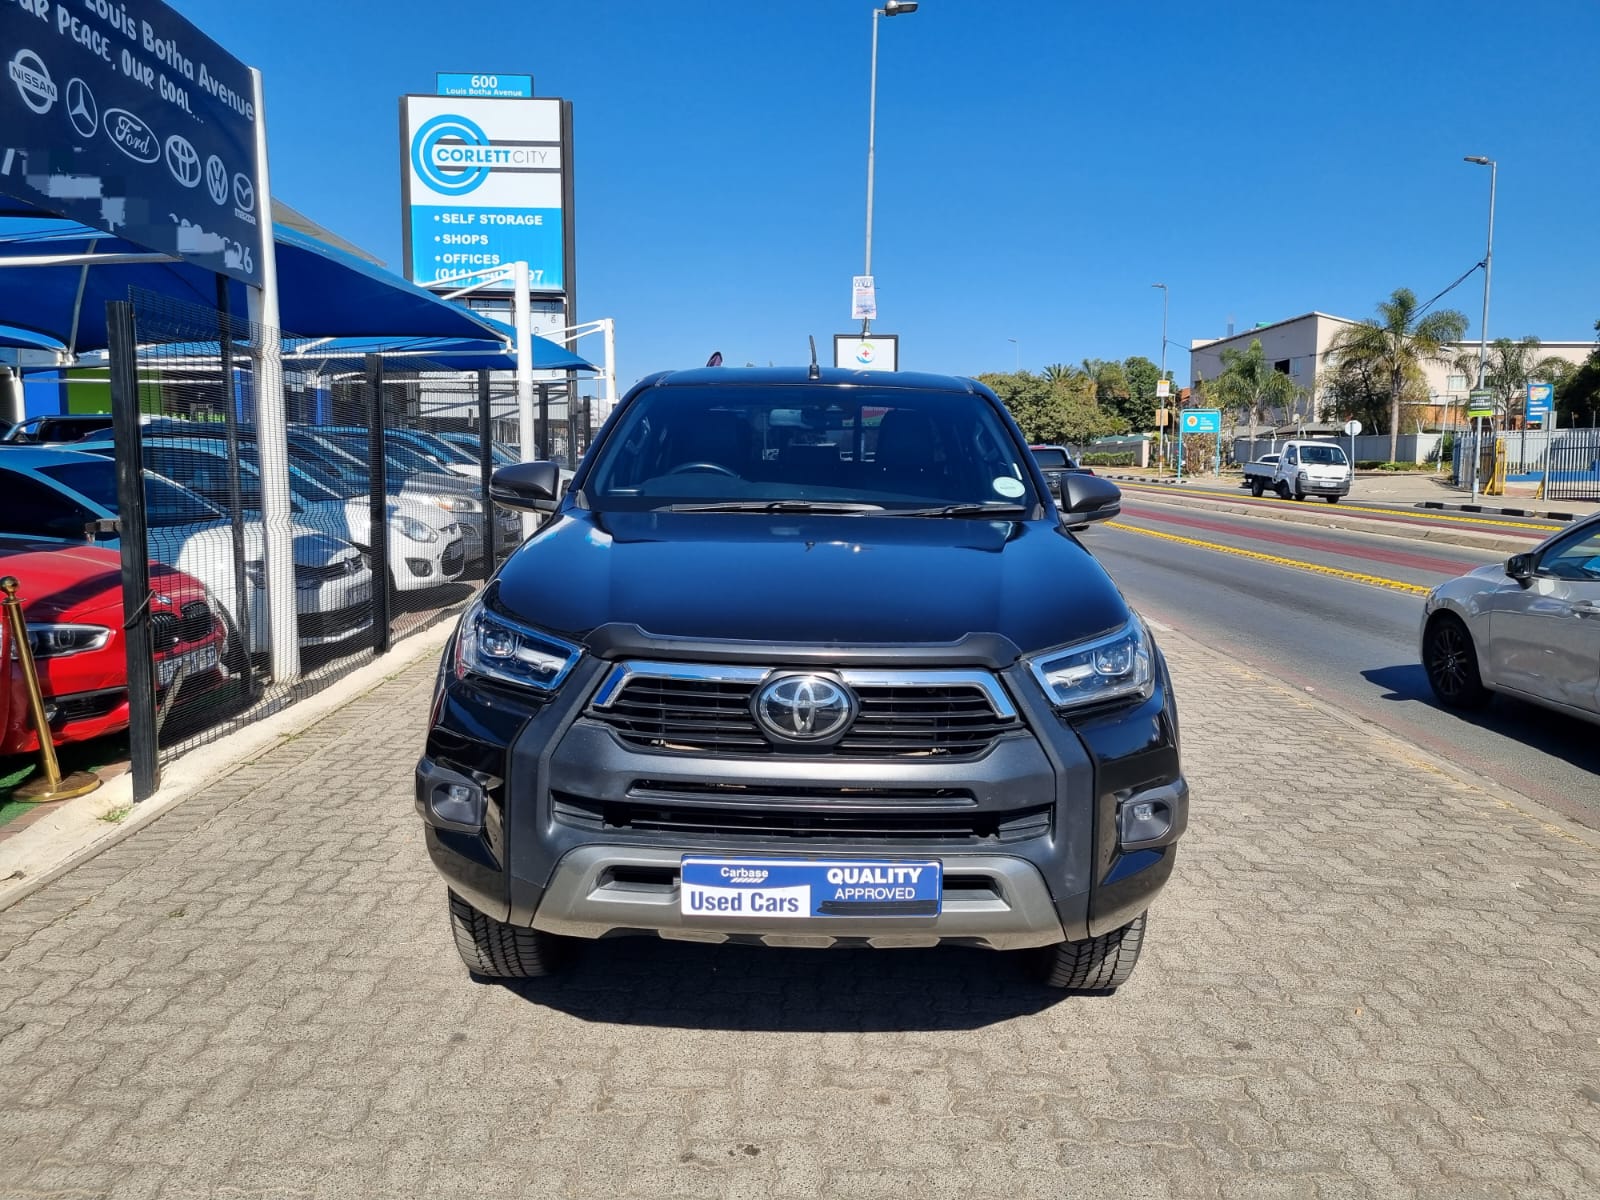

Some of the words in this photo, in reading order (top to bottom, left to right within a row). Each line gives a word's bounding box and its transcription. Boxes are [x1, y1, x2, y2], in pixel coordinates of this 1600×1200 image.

[121, 48, 154, 90] OUR
[142, 19, 194, 81] Botha
[198, 63, 255, 121] Avenue
[11, 65, 56, 98] NISSAN
[471, 75, 498, 89] 600
[446, 87, 467, 95] Louis
[468, 88, 492, 96] Botha
[493, 88, 523, 97] Avenue
[115, 115, 150, 155] Ford
[442, 213, 476, 225] SELF
[479, 214, 544, 226] STORAGE
[442, 233, 489, 245] SHOPS
[442, 253, 500, 265] OFFICES
[720, 867, 769, 878] Carbase
[826, 867, 922, 886] QUALITY
[834, 887, 916, 900] APPROVED
[690, 890, 743, 912] Used
[750, 891, 800, 913] Cars
